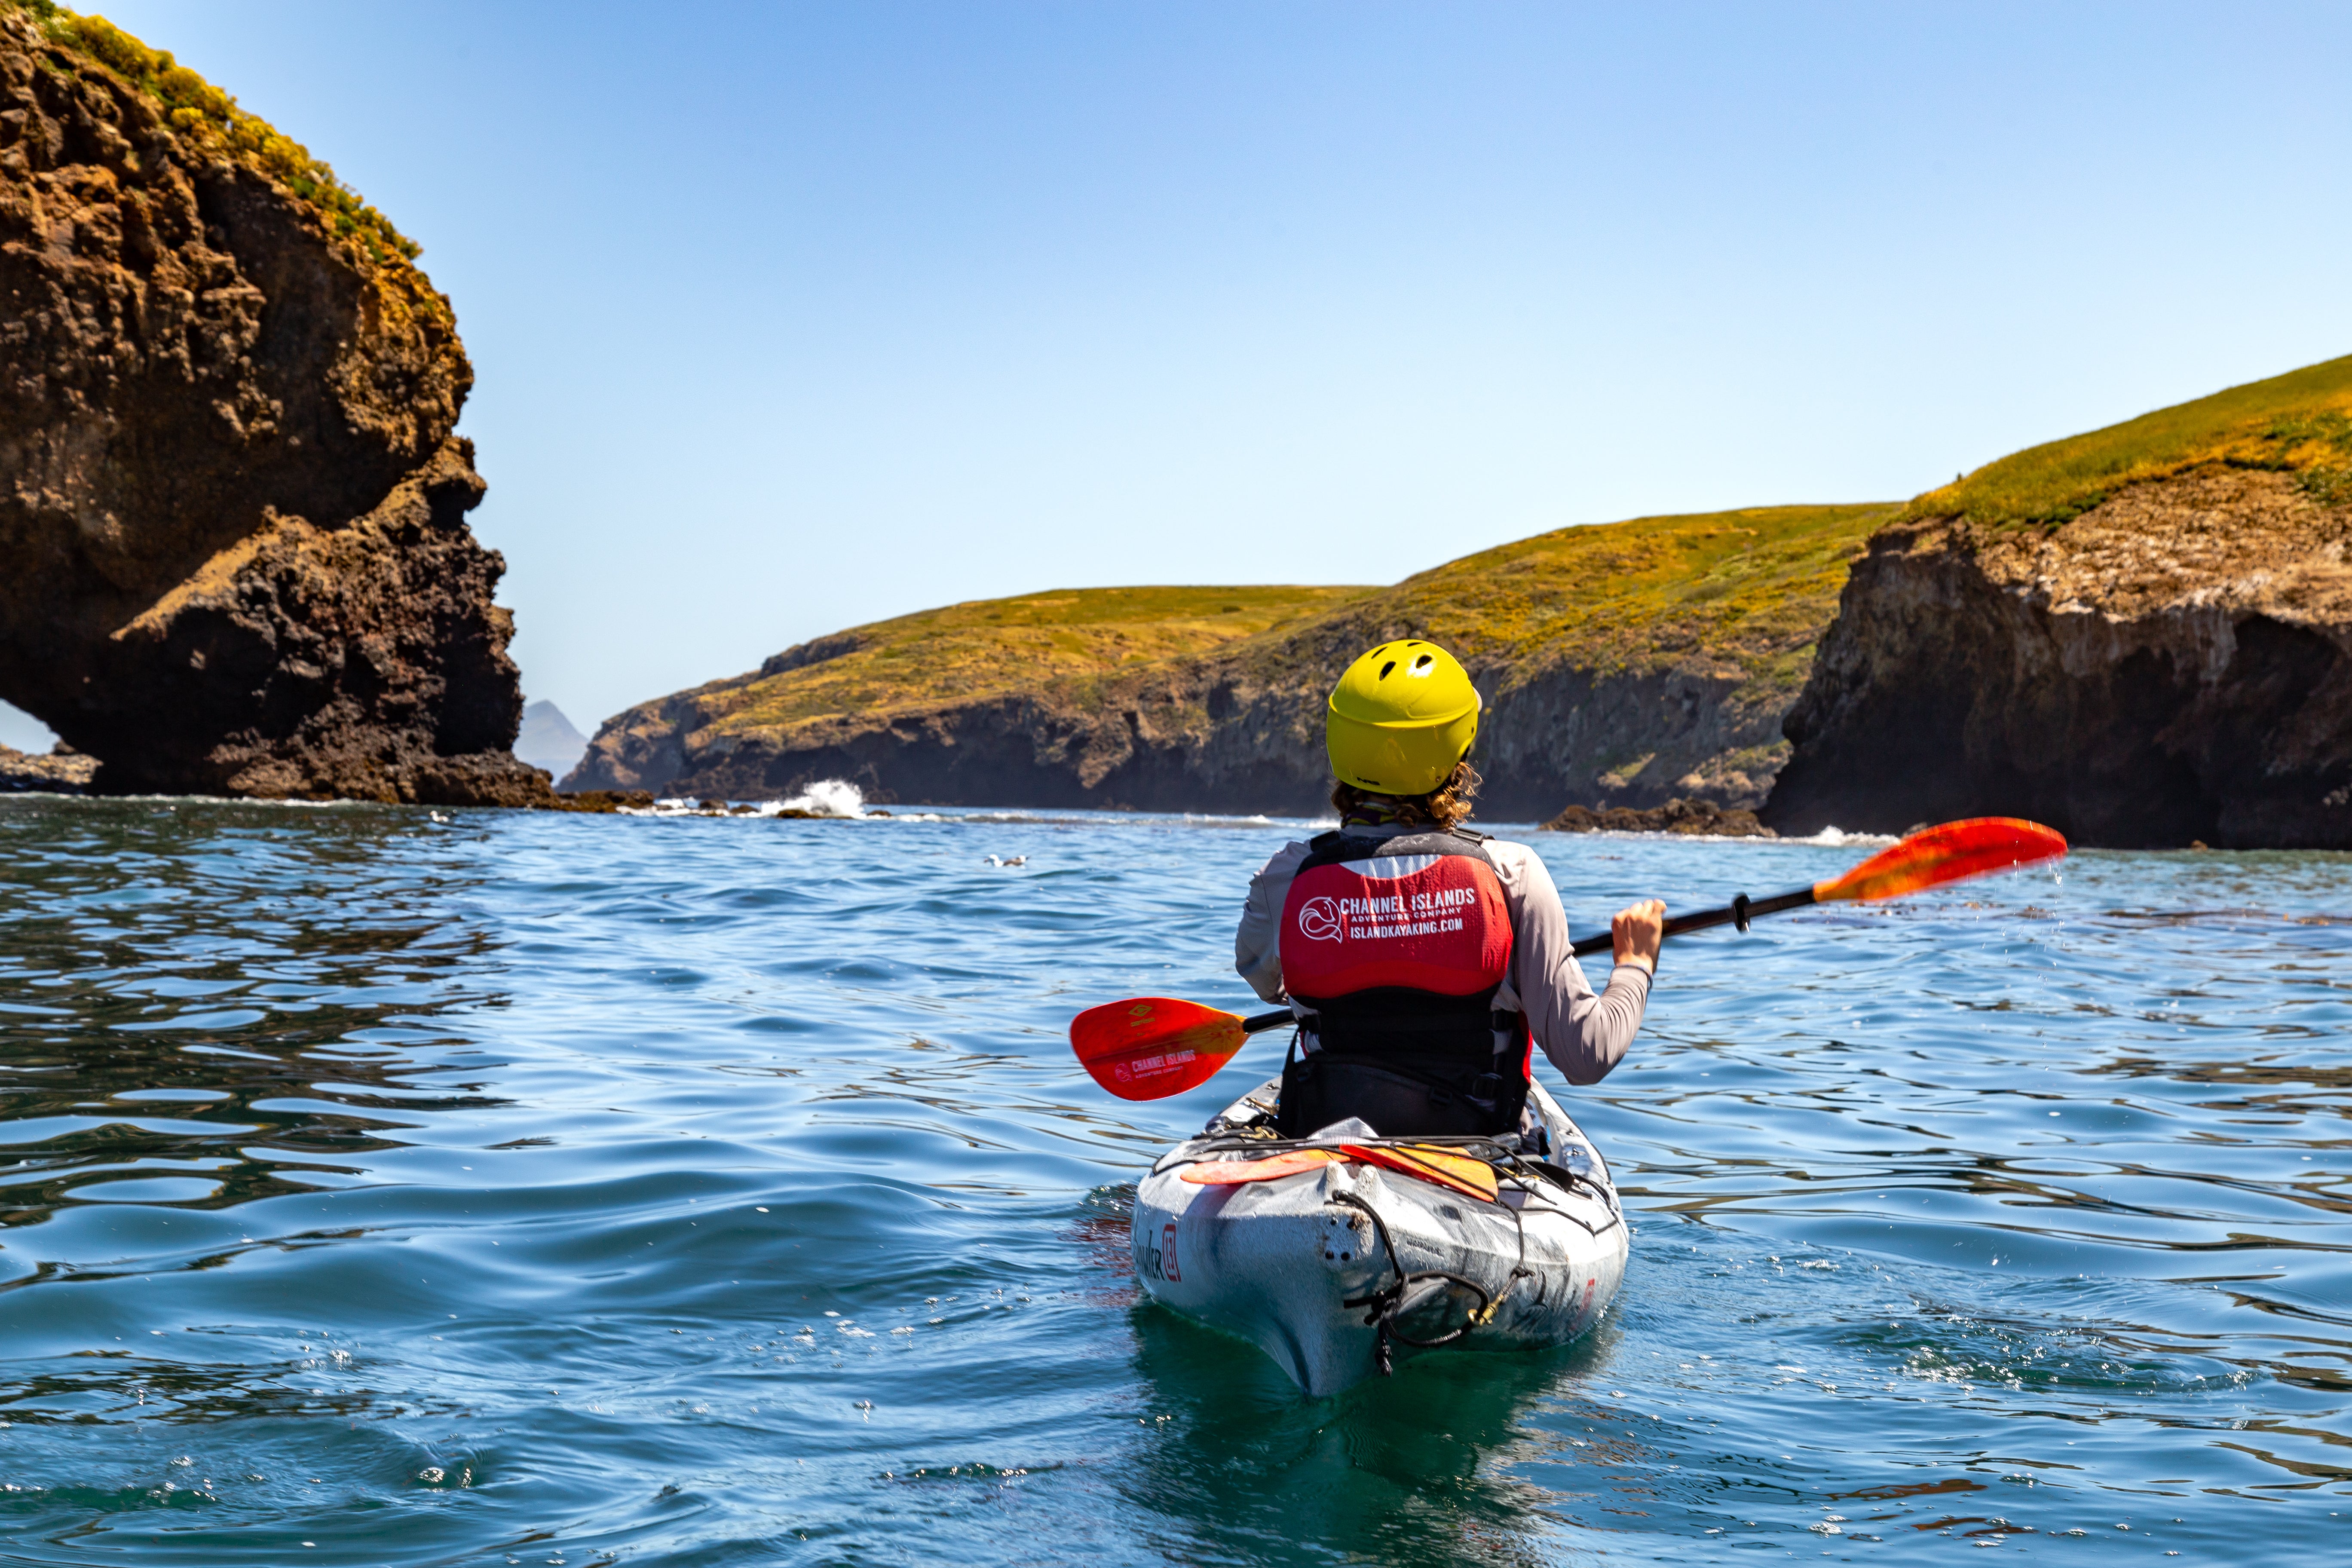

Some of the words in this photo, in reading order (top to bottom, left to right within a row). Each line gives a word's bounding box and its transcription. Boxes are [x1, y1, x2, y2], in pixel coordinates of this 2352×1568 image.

[1340, 895, 1407, 915] CHANNEL
[1412, 887, 1475, 911] ISLANDS
[1351, 912, 1410, 922] ADVENTURE
[1413, 906, 1462, 919] COMPANY
[1350, 918, 1463, 939] ISLANDKAYAKING.COM
[1132, 1056, 1166, 1072] CHANNEL
[1165, 1049, 1196, 1065] ISLANDS
